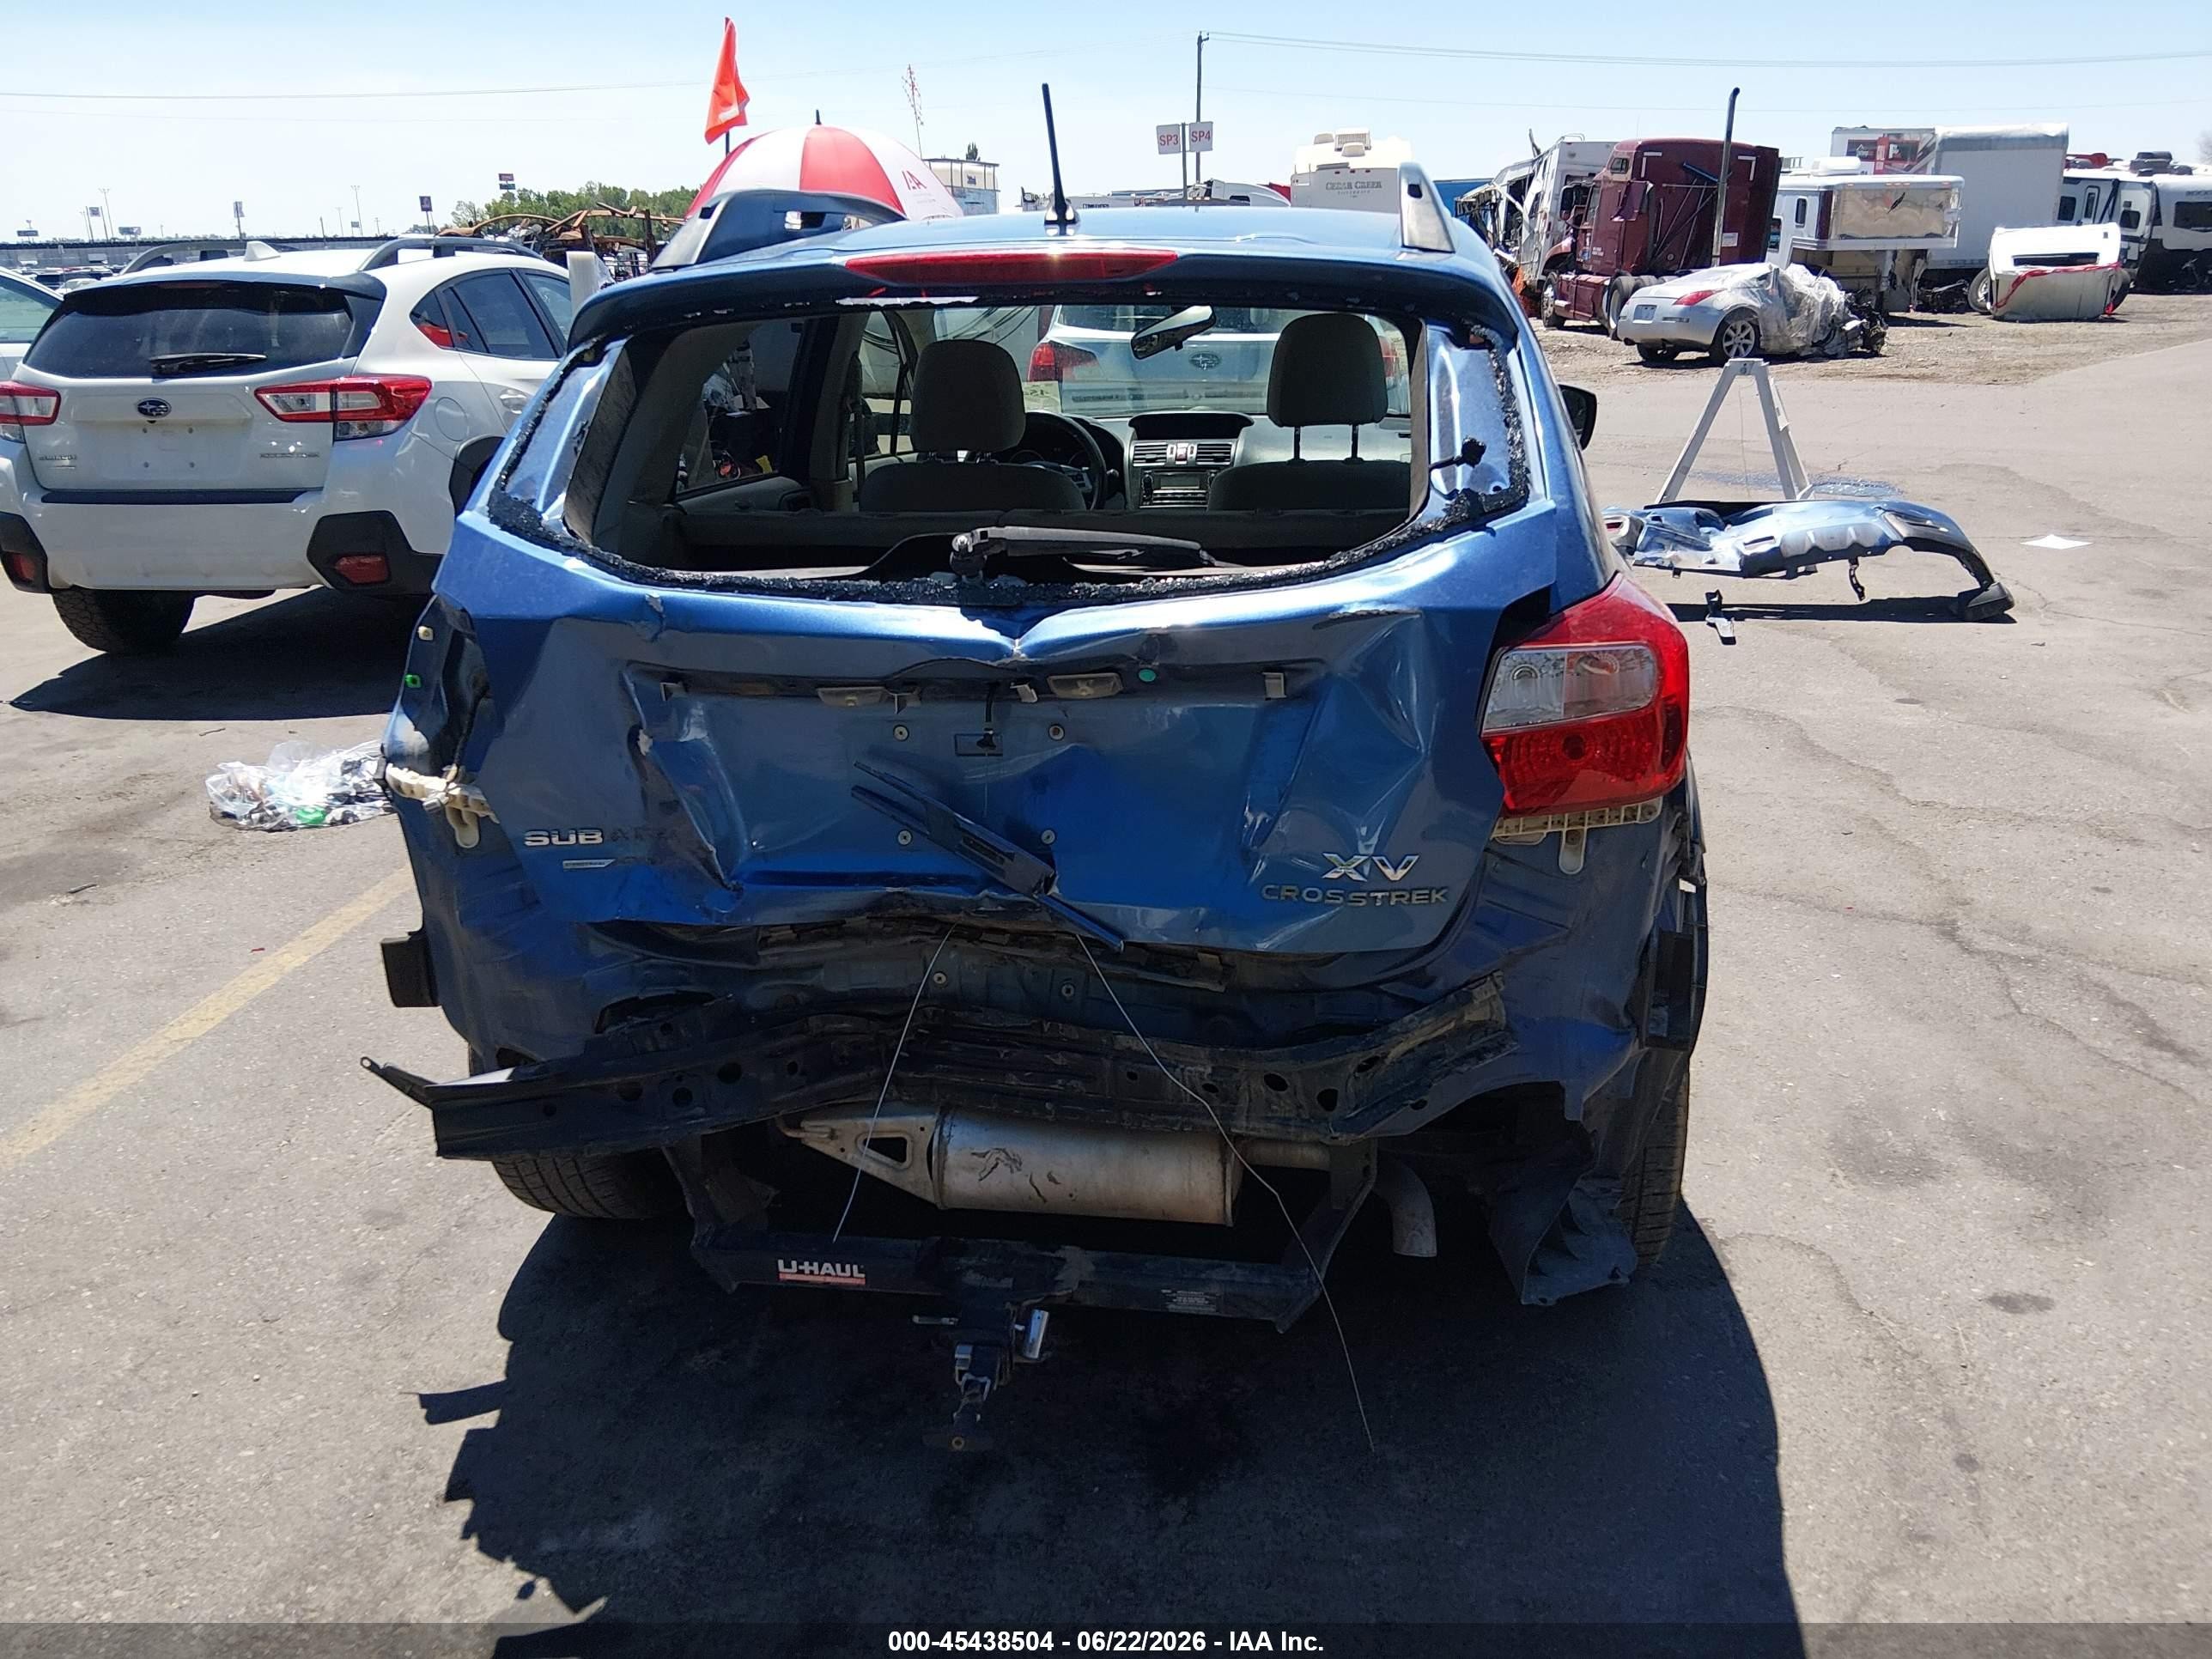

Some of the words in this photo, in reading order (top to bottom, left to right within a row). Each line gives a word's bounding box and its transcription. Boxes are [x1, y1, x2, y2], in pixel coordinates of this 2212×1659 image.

[1159, 134, 1179, 146] SP3
[1191, 130, 1211, 143] SP4
[1322, 852, 1419, 882] XV
[1261, 884, 1449, 907] CROSSTREK
[777, 1259, 866, 1279] U-HAUL
